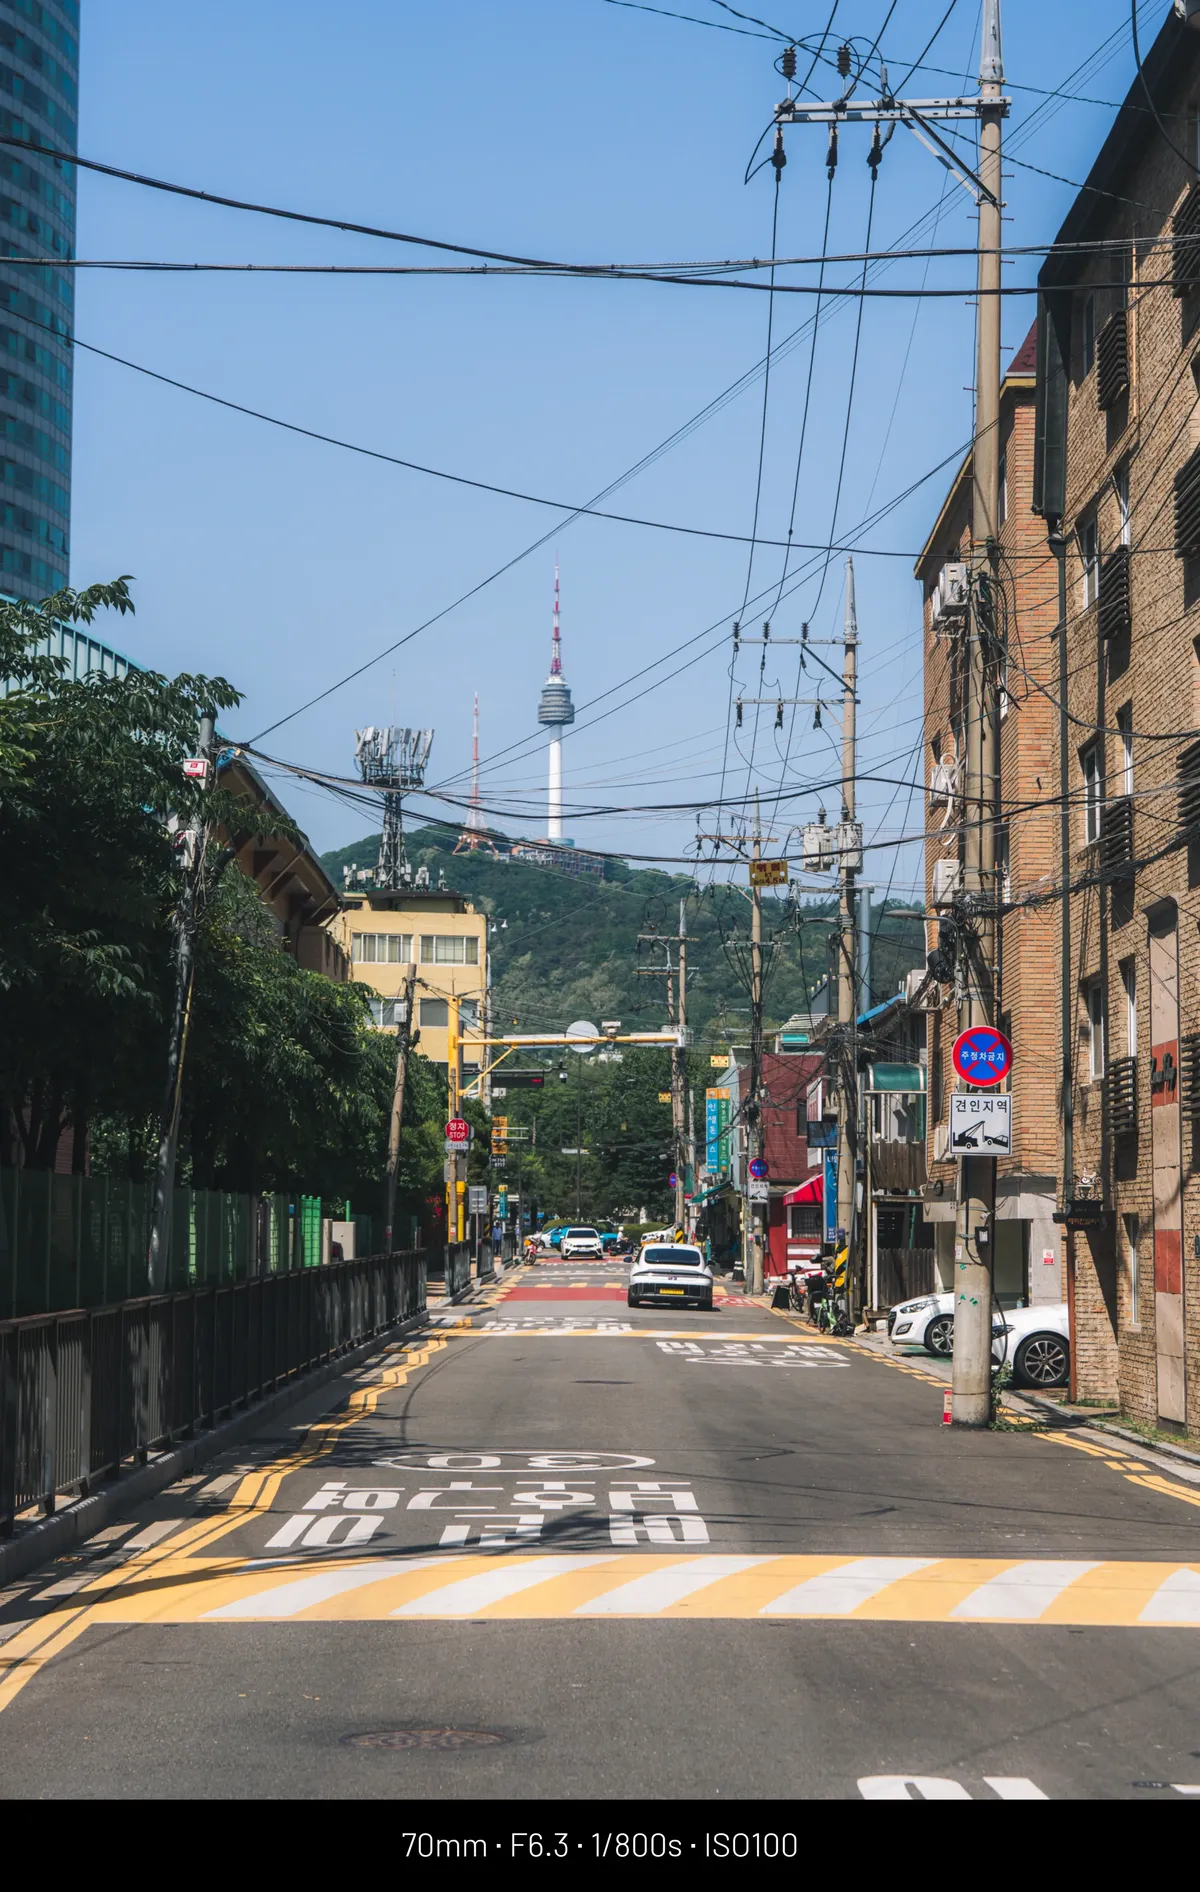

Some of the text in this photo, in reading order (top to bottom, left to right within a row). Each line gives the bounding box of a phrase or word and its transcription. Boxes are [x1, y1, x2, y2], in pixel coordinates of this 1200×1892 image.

[961, 1051, 1005, 1061] 주정차금지
[955, 1099, 1008, 1113] 견인지역
[448, 1122, 465, 1130] 정지
[448, 1131, 466, 1139] STOP
[302, 1481, 700, 1511] 보호구역
[264, 1513, 711, 1549] 어린이
